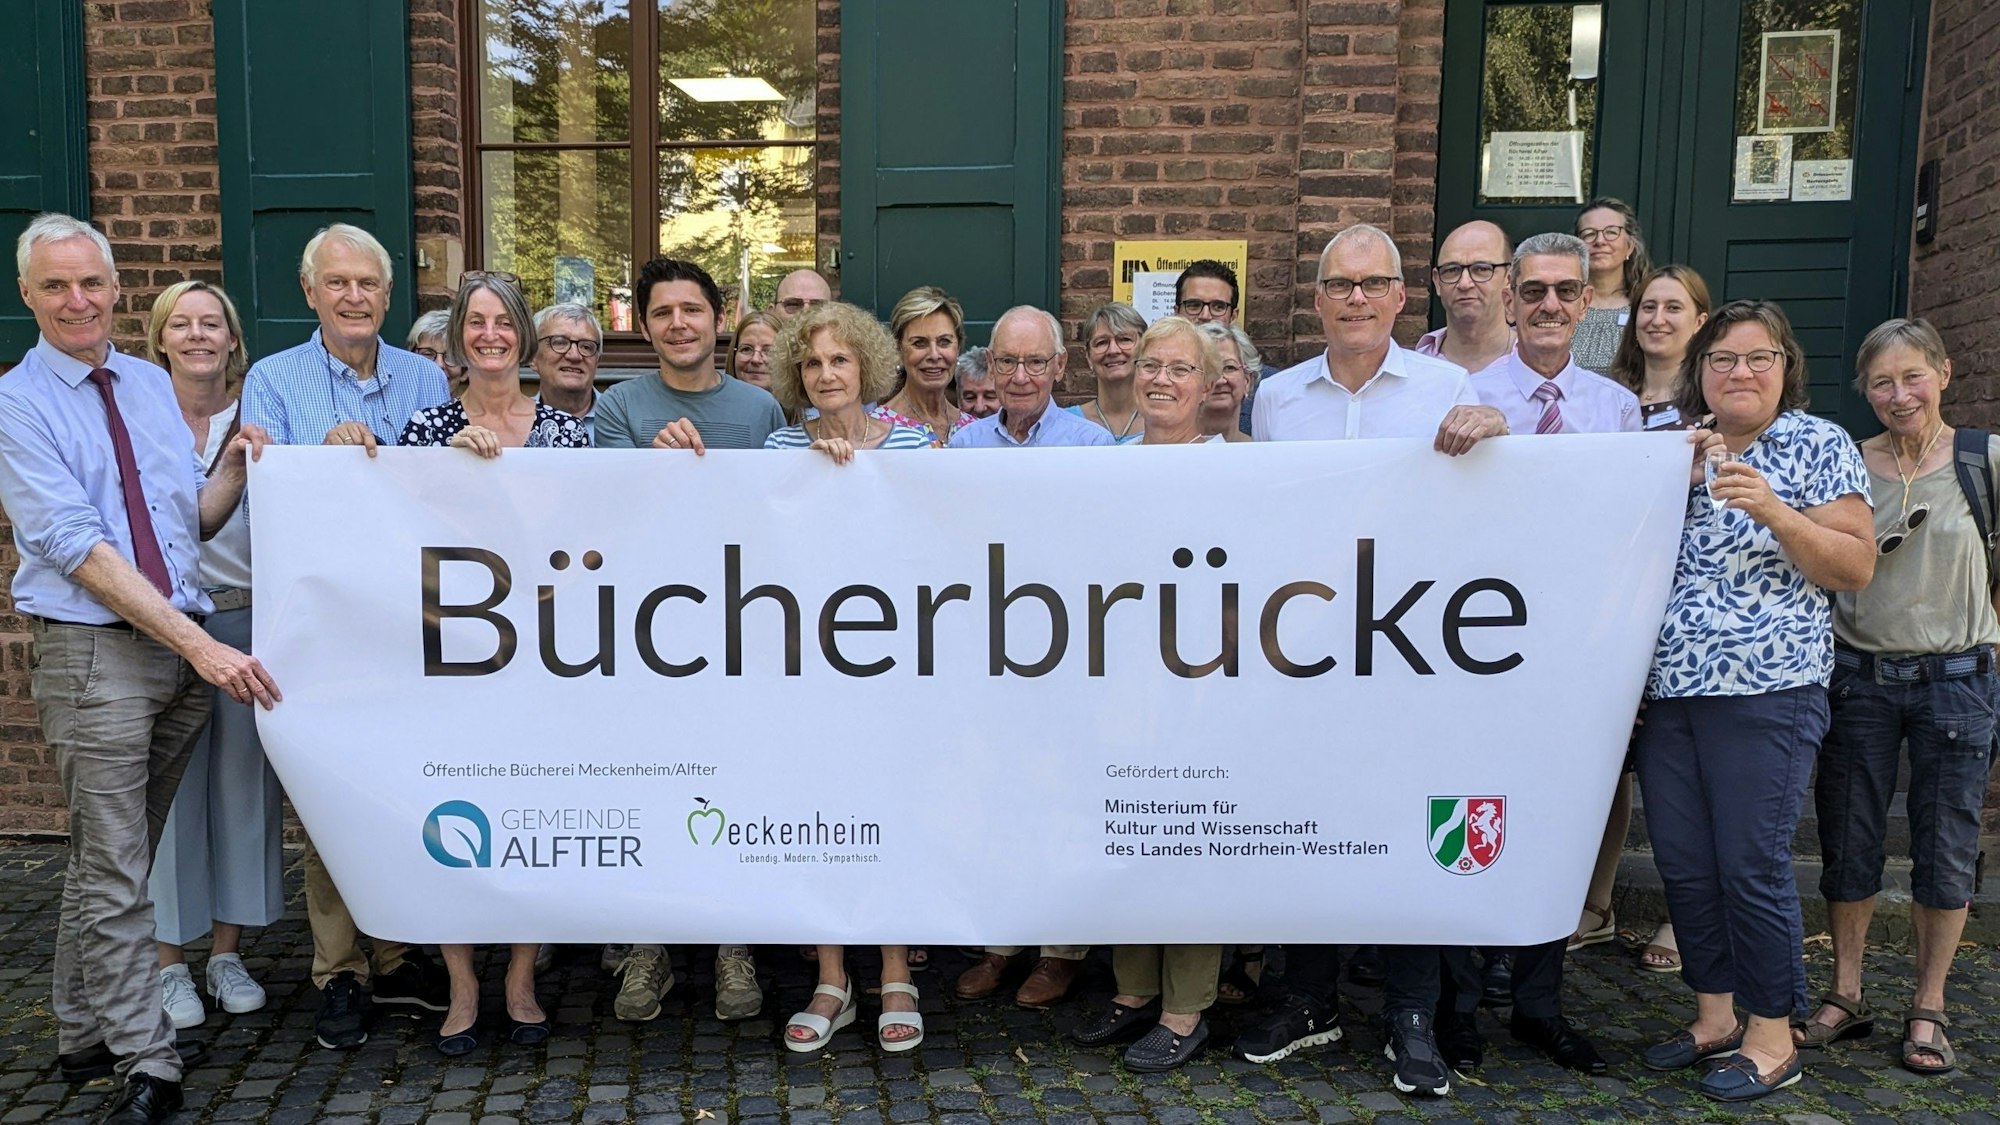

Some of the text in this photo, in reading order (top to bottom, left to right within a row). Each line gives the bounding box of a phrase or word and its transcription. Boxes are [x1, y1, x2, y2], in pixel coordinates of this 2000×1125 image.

[1152, 281, 1177, 289] Öffnung
[421, 538, 1527, 678] Bücherbrücke
[423, 761, 718, 777] Öffentliche Bücherei Meckenheim/Alfter
[1106, 764, 1230, 779] Gefördert durch:
[1105, 799, 1238, 815] Ministerium für
[501, 808, 641, 830] GEMEINDE
[1105, 820, 1319, 836] Kultur und Wissenschaft
[500, 836, 643, 868] ALFTER
[1105, 840, 1389, 857] des Landes Nordrhein-Westfalen
[739, 852, 881, 865] Lebendig. Modern. Sympathisch.
